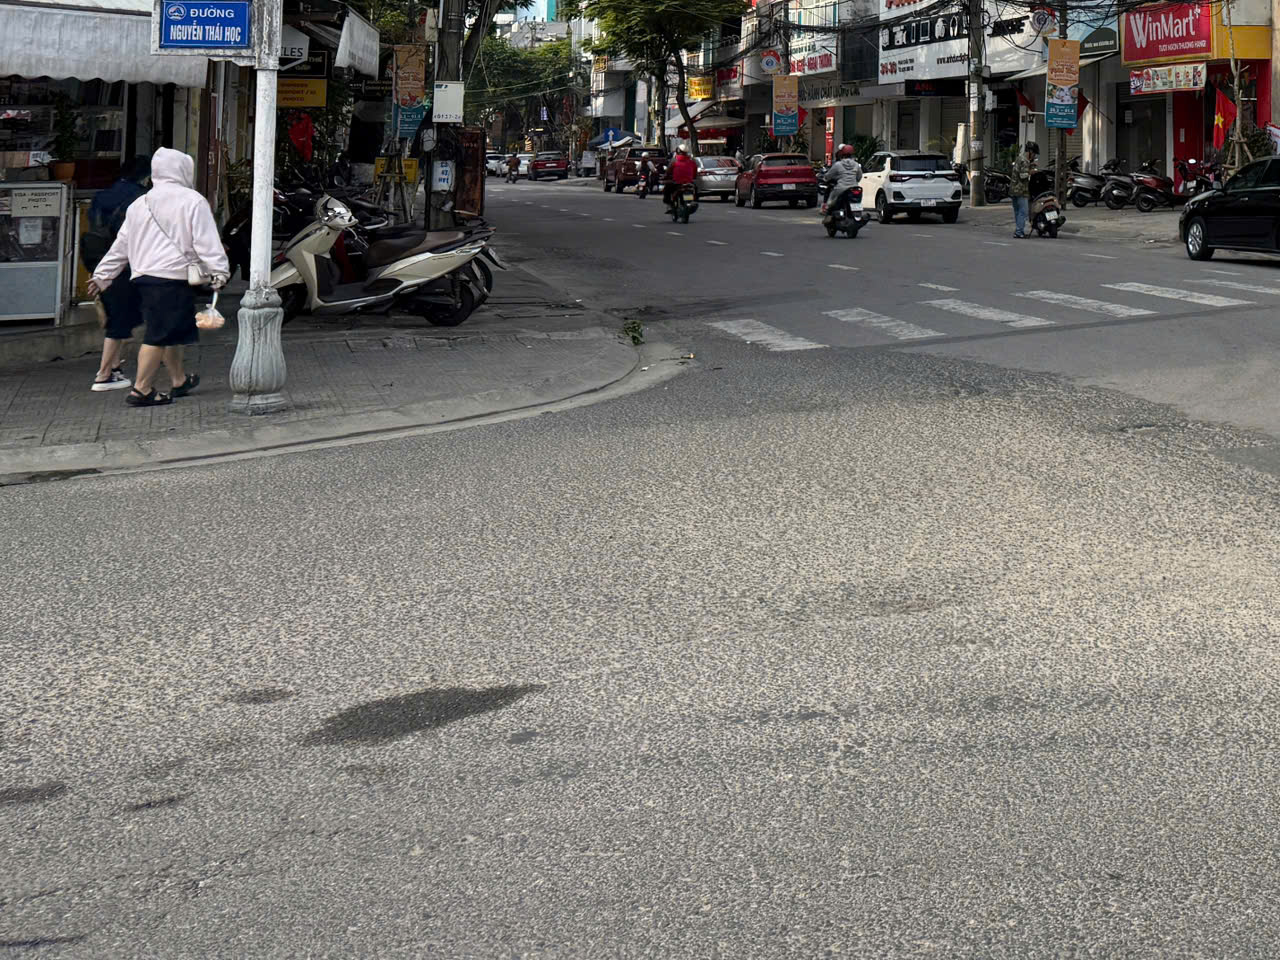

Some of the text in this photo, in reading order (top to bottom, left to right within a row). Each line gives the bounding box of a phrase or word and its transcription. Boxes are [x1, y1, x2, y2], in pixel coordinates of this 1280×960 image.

[189, 5, 235, 18] ĐƯỜNG
[170, 20, 241, 44] NGUYỄN THÁI HỌC
